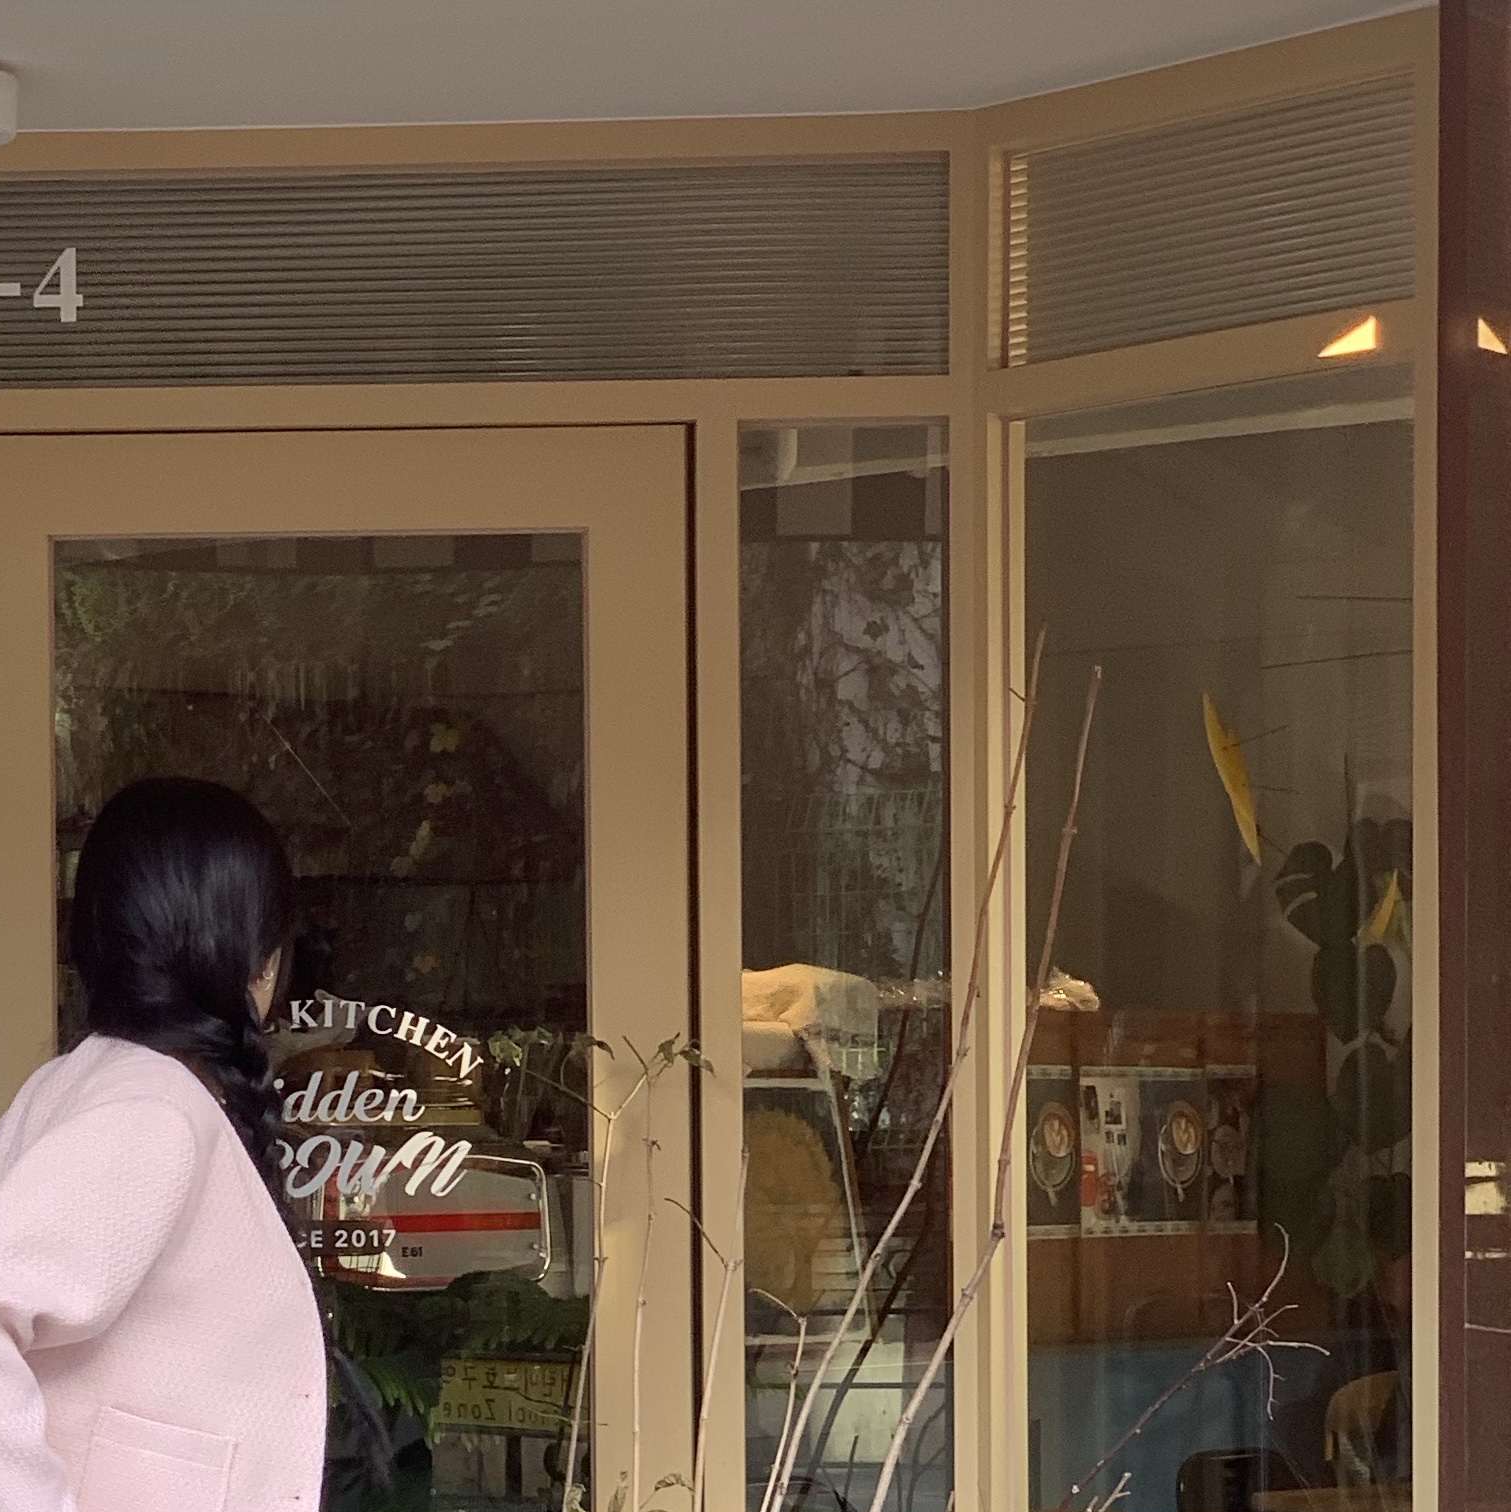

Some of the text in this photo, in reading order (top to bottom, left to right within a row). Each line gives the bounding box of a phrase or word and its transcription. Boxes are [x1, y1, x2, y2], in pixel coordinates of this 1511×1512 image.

[289, 999, 485, 1080] KITCHEN
[274, 1070, 425, 1123] dden
[334, 1229, 397, 1248] 2017
